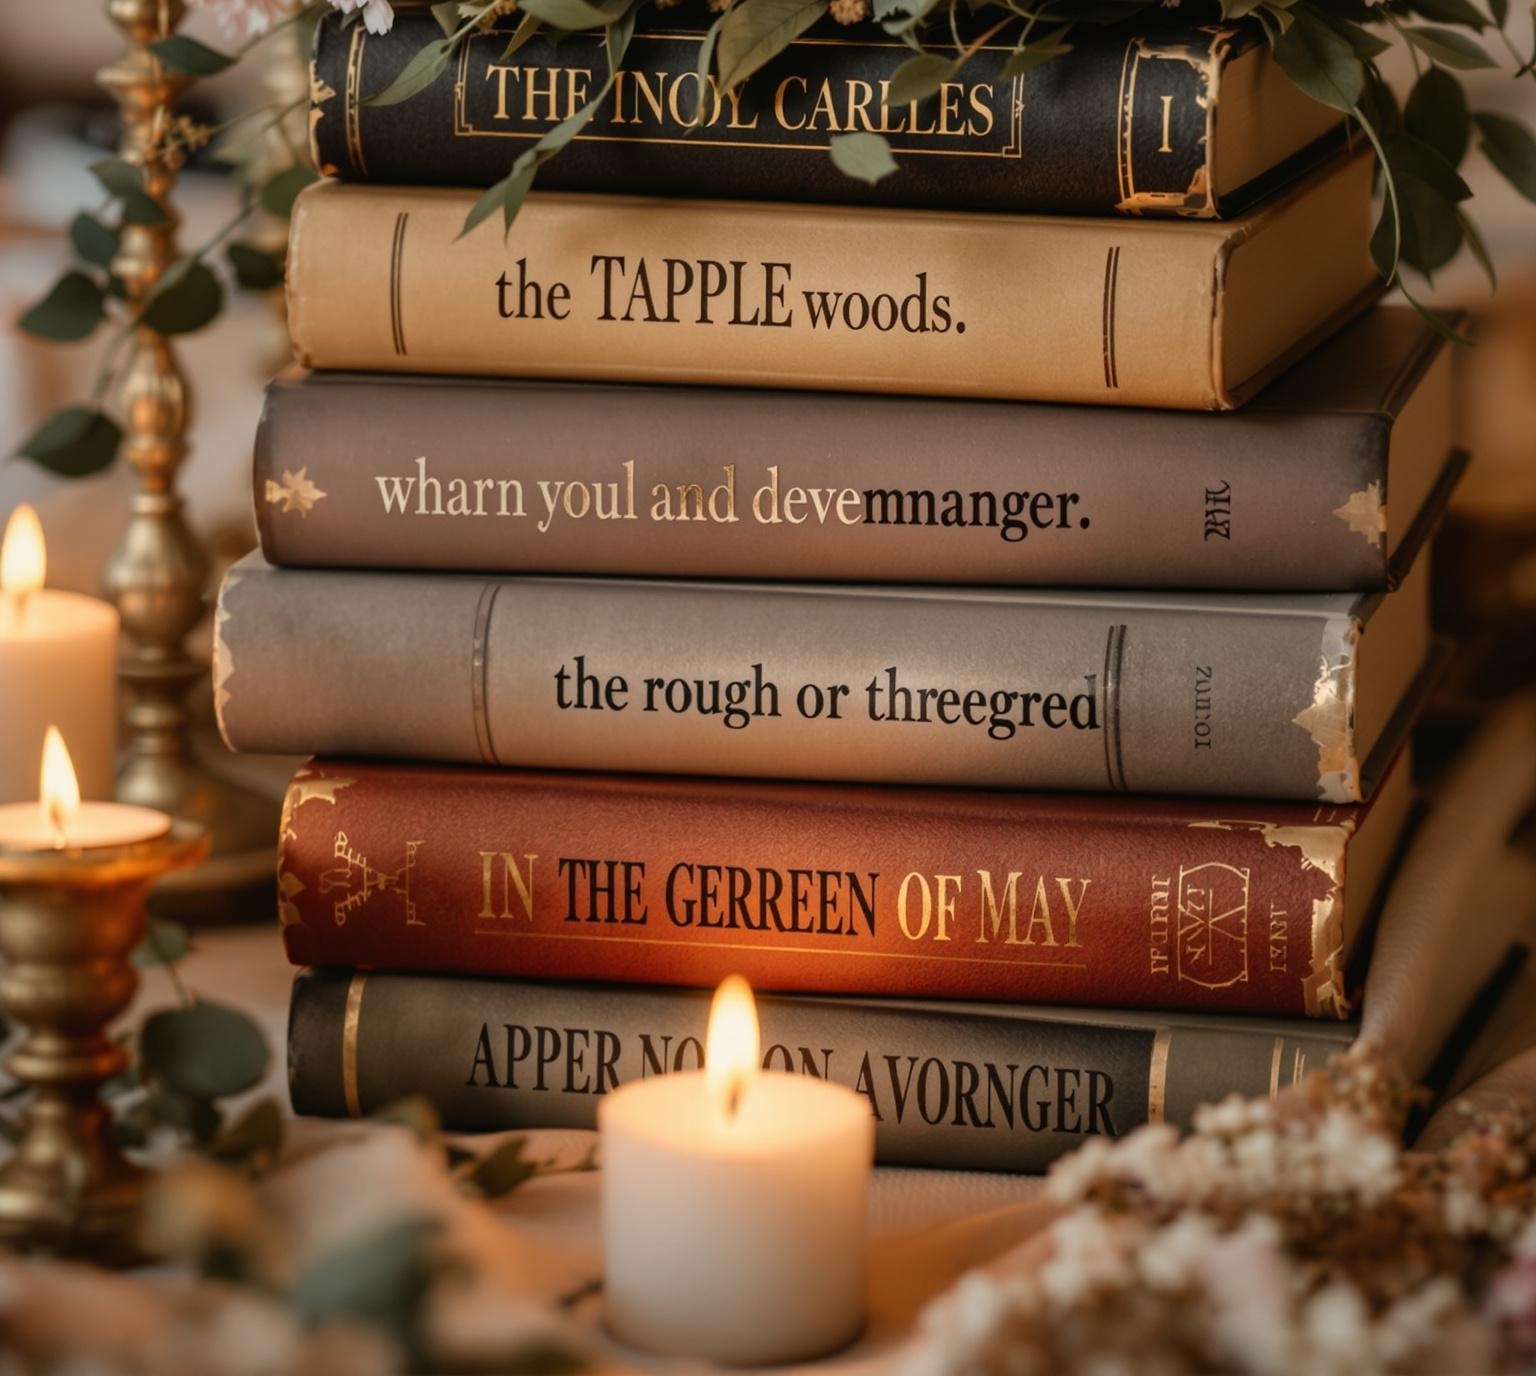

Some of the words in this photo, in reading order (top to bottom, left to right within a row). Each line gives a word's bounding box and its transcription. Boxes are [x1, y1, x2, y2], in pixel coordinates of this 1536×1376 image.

[486, 63, 593, 123] THE
[495, 257, 572, 319] the
[591, 255, 793, 328] TAPPLE
[802, 272, 967, 335] woods.
[375, 456, 527, 517] wharn
[537, 460, 638, 533] youl
[650, 464, 740, 523] and
[554, 655, 629, 712] the
[642, 664, 782, 729] rough
[796, 681, 851, 720] or
[865, 667, 1101, 740] threegred
[477, 851, 540, 922] IN
[558, 858, 649, 925] THE
[665, 861, 880, 937] GERREEN
[897, 871, 962, 941] OF
[975, 869, 1092, 949] MAY
[465, 1022, 621, 1095] APPER
[855, 1051, 1118, 1136] AVORNGER
